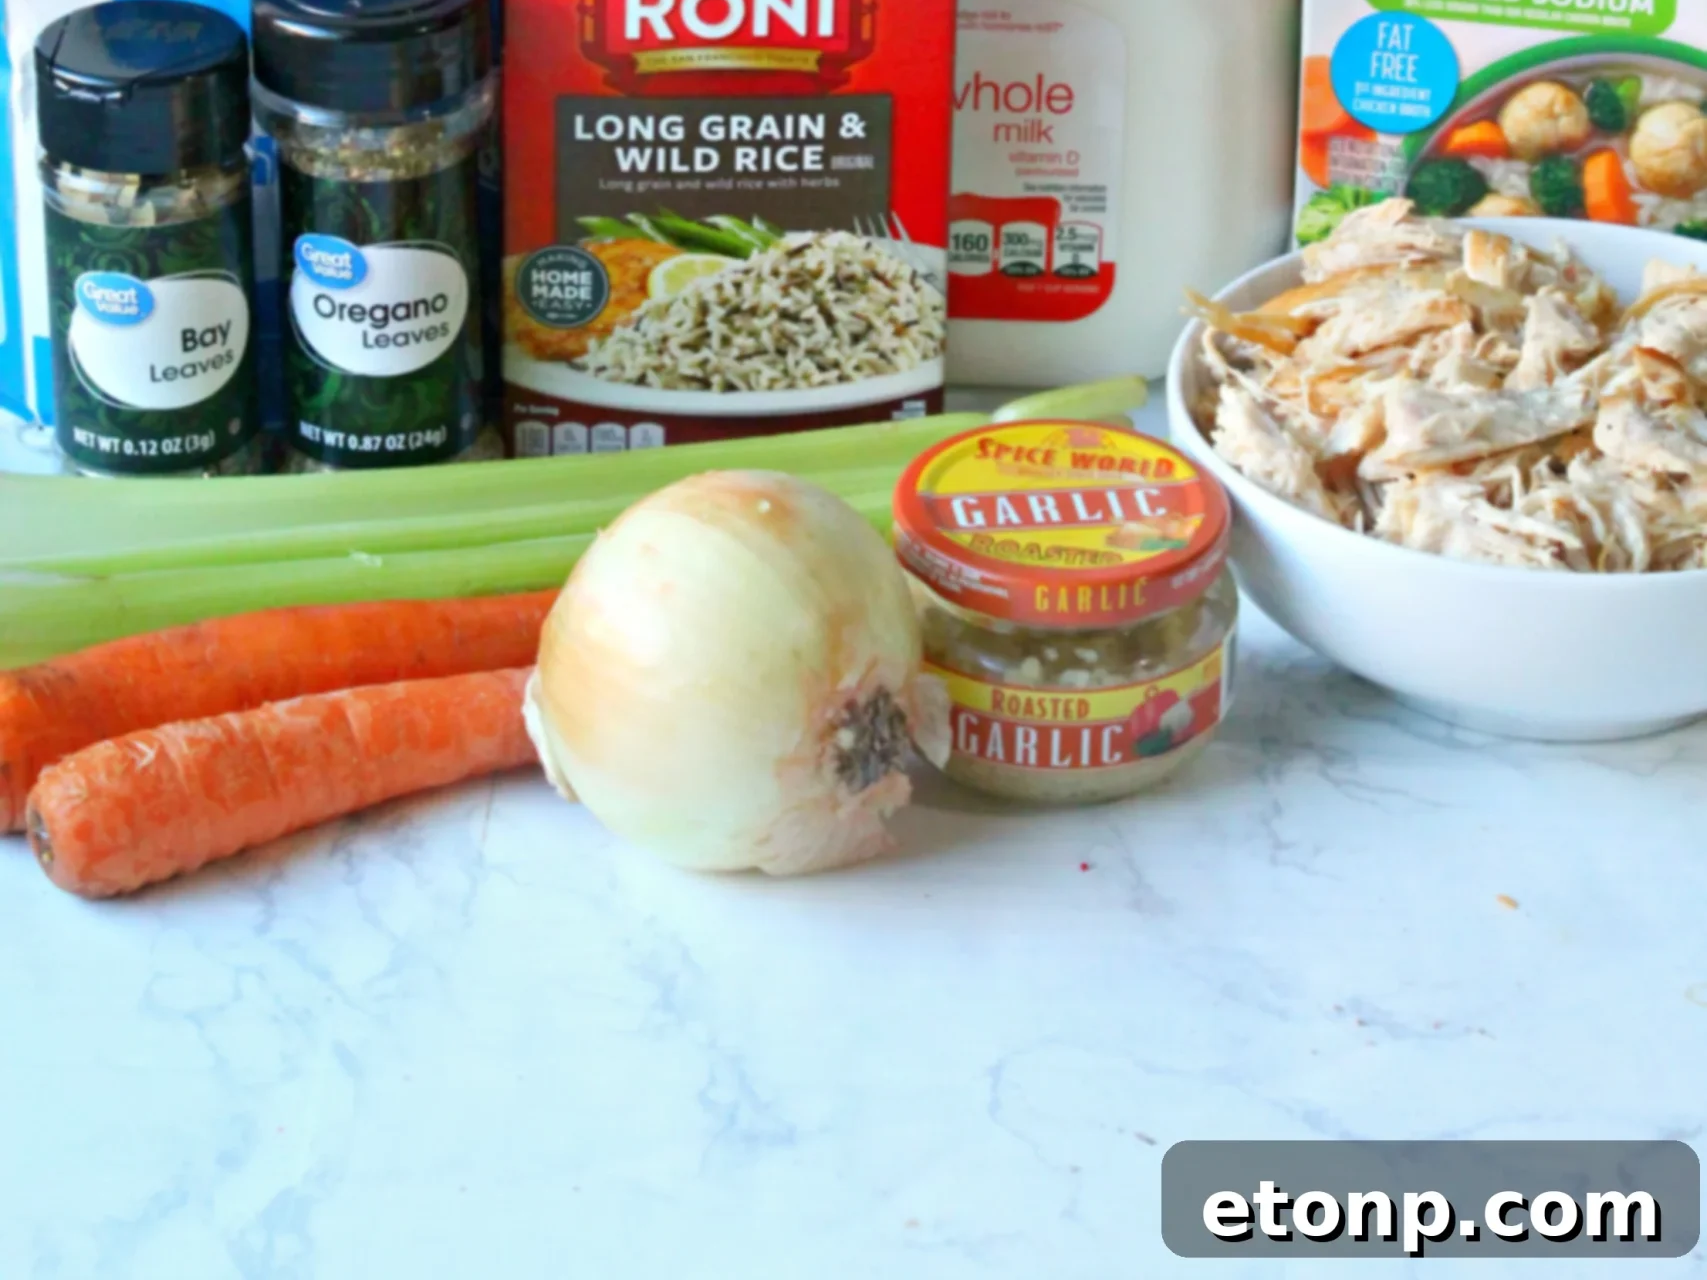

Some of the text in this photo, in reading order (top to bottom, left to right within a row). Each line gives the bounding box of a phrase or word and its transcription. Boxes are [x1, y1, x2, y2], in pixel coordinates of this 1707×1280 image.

[1376, 21, 1415, 51] FAT
[1370, 51, 1419, 83] FREE
[573, 113, 866, 141] LONG GRAIN &
[993, 118, 1055, 144] milk
[615, 147, 720, 172] WILD
[734, 145, 824, 171] RICE
[1066, 149, 1080, 165] D
[599, 175, 840, 193] Long grain and wild rice with herbs
[302, 242, 352, 270] Great
[952, 233, 989, 252] 160
[531, 268, 592, 286] HOME
[83, 280, 138, 305] Great
[531, 285, 592, 300] MADE
[313, 292, 448, 329] Oregano
[181, 319, 231, 353] Bay
[362, 322, 449, 349] Leaves
[150, 349, 234, 383] Leaves
[73, 426, 96, 448] NET
[98, 433, 121, 453] WT
[123, 436, 159, 456] 0.12
[161, 435, 183, 454] OZ
[300, 421, 322, 443] NET
[322, 429, 346, 449] WT
[349, 432, 383, 451] 0.87
[385, 431, 406, 450] OZ
[975, 437, 1055, 466] SPICE
[1071, 451, 1175, 480] WORLD
[950, 487, 1168, 529] GARLIC
[968, 532, 1124, 565] ROASTED
[1034, 577, 1149, 613] GARLIC
[990, 688, 1091, 721] ROASTED
[957, 711, 1125, 768] GARLIC
